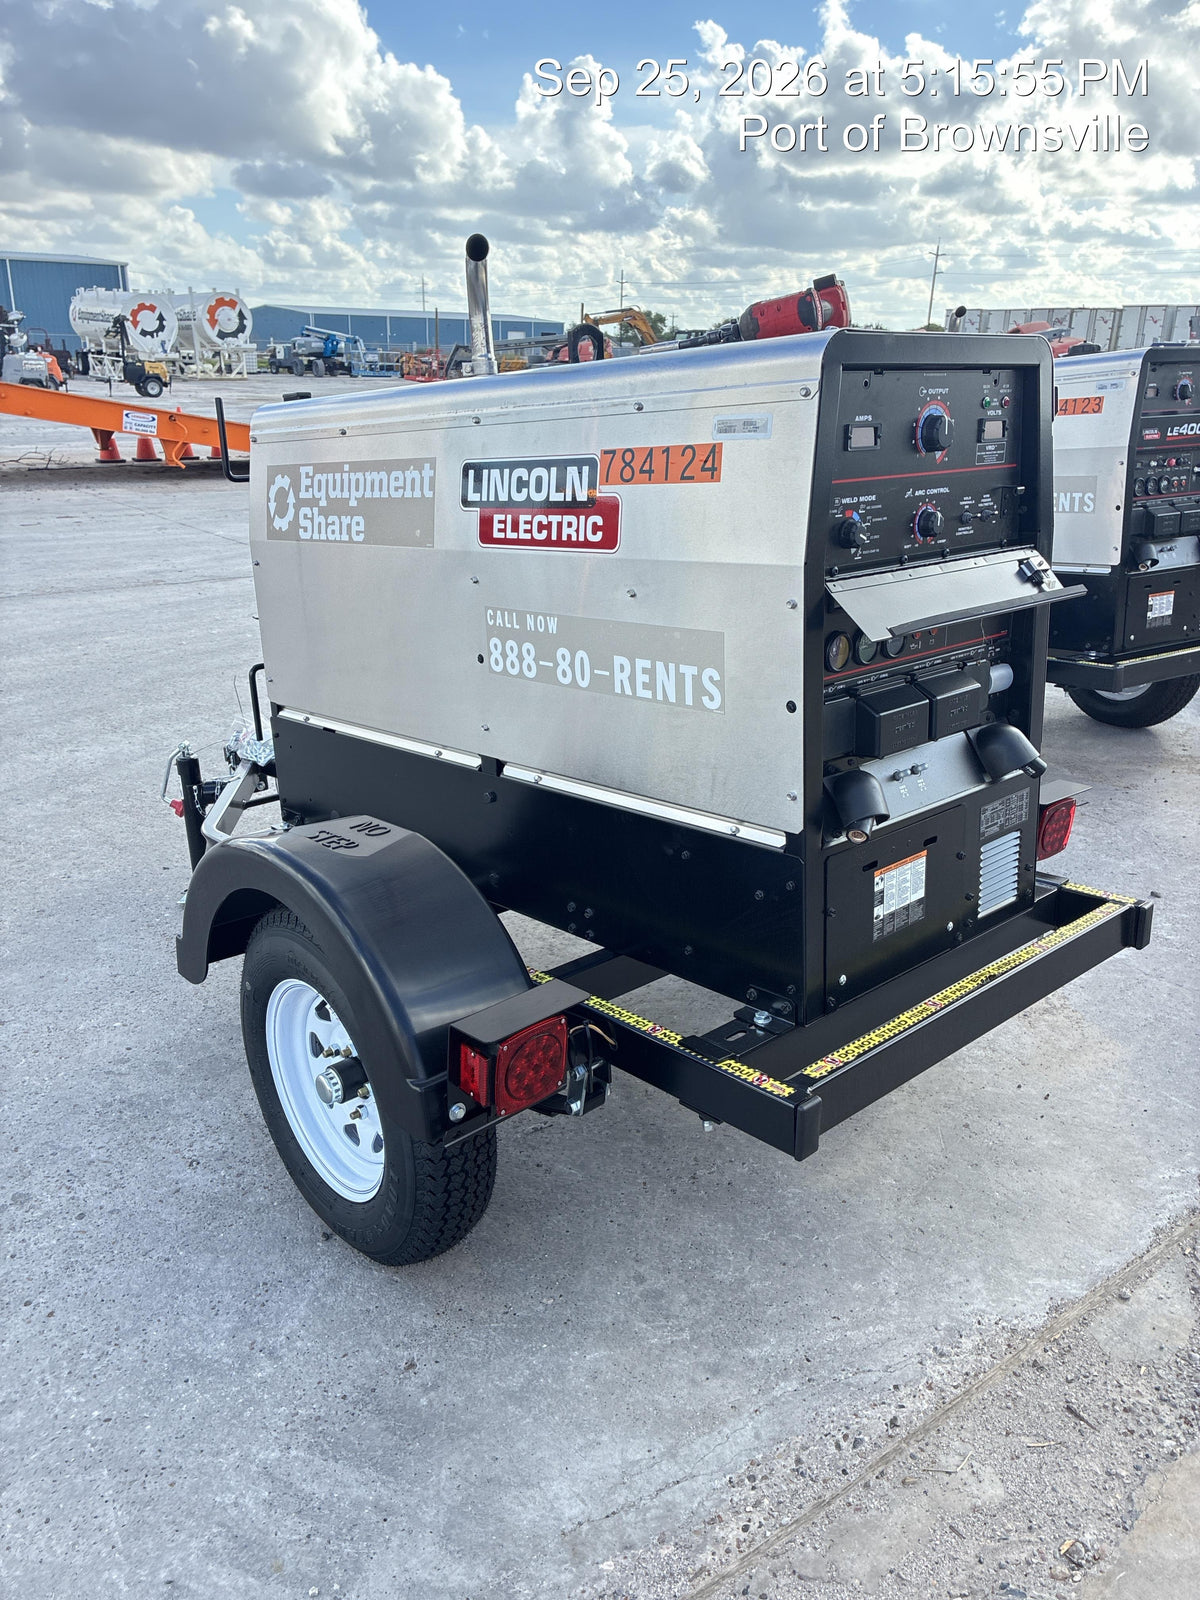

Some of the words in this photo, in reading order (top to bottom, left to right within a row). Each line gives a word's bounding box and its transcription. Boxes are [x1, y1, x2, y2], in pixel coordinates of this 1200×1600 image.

[1059, 396, 1102, 415] 4123
[603, 443, 719, 483] 784124
[299, 463, 434, 507] Equipment
[467, 465, 590, 503] LINCOLN
[926, 487, 950, 495] CONTROL
[298, 506, 365, 542] Share
[492, 513, 604, 543] ELECTRIC
[486, 609, 520, 630] CALL
[526, 614, 558, 634] NOW
[489, 637, 722, 710] 888-80-RENTS
[304, 830, 360, 850] STEP
[349, 821, 391, 837] NO
[593, 1000, 635, 1020] DEBOUT
[838, 1048, 855, 1059] DO
[854, 1037, 878, 1051] NOT
[874, 1019, 908, 1038] STAND
[906, 1007, 933, 1021] HERE
[938, 993, 953, 1003] NE
[952, 984, 969, 995] PAS
[660, 1031, 678, 1042] NO
[722, 1062, 755, 1078] AQUI
